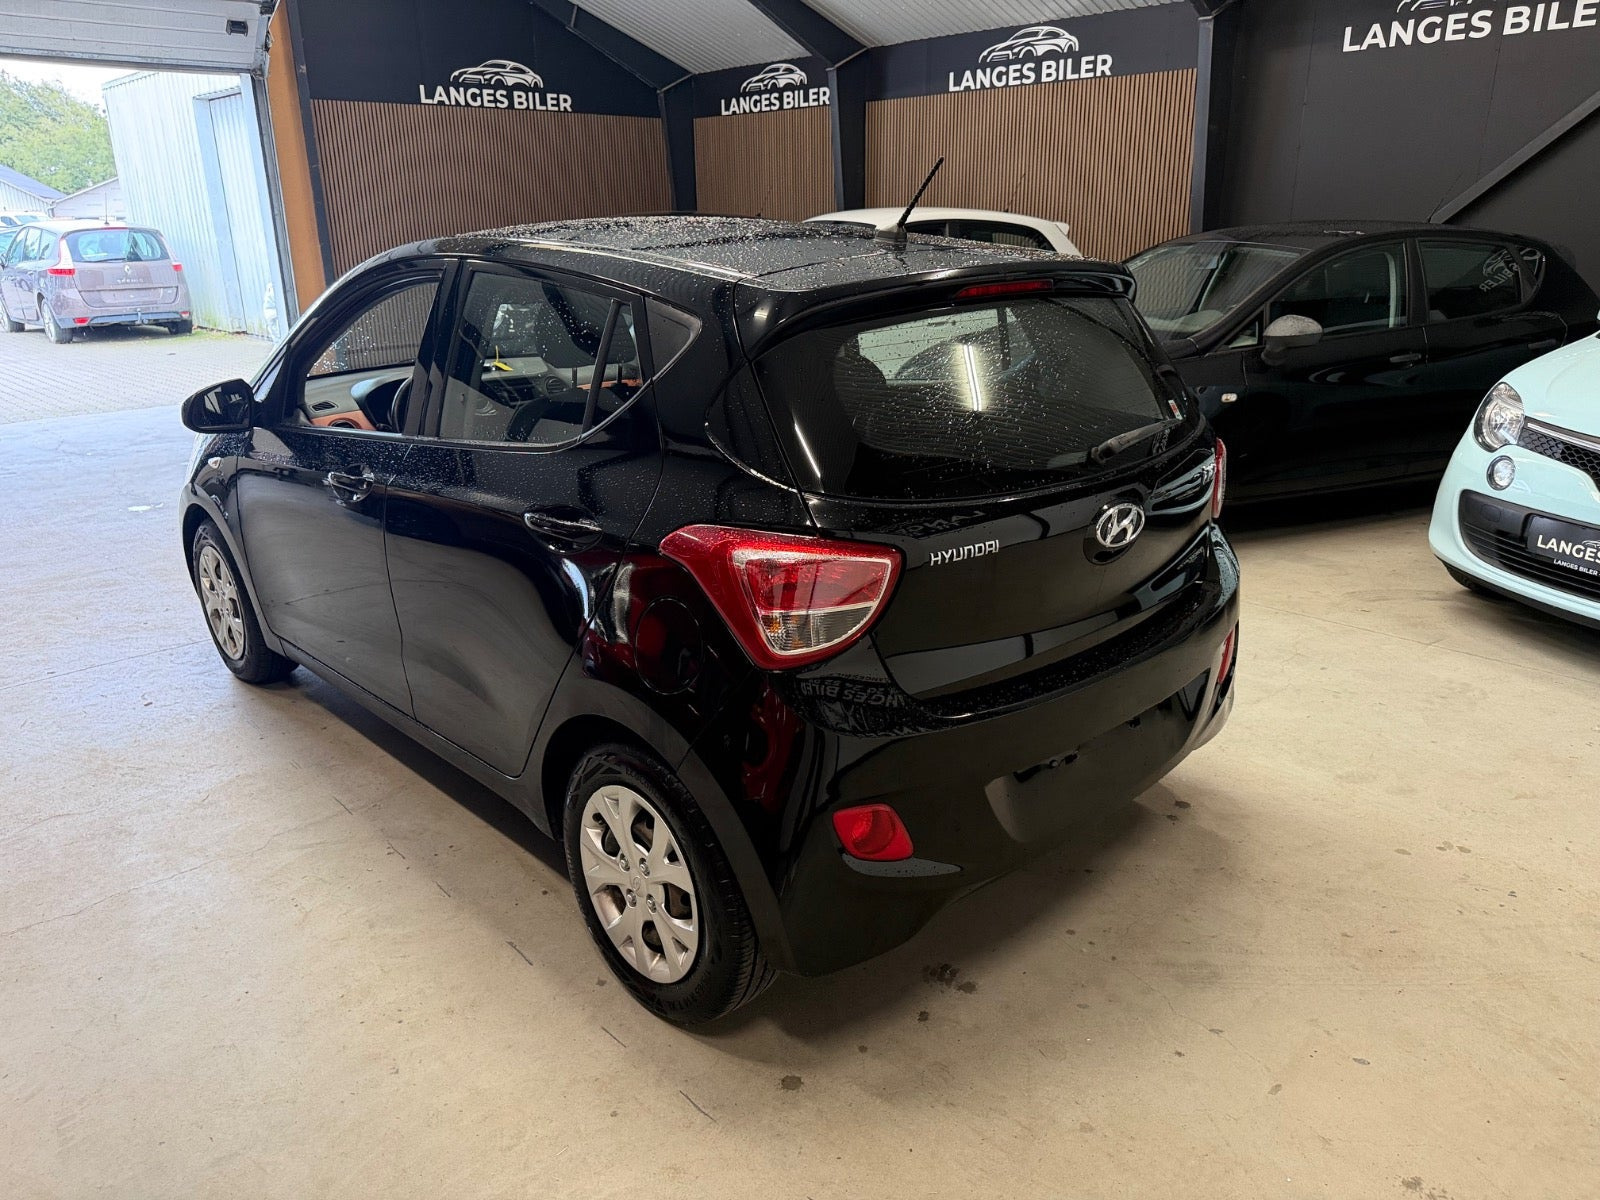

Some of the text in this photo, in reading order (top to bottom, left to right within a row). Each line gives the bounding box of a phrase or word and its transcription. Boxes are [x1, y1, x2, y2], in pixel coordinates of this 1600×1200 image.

[1342, 9, 1494, 53] LANGES
[948, 53, 1113, 92] LANGES BILER
[419, 84, 573, 112] LANGES BILER
[721, 86, 831, 116] LANGES BILER
[929, 539, 1000, 567] HYUNDAI
[1553, 558, 1599, 576] LANGES BILER
